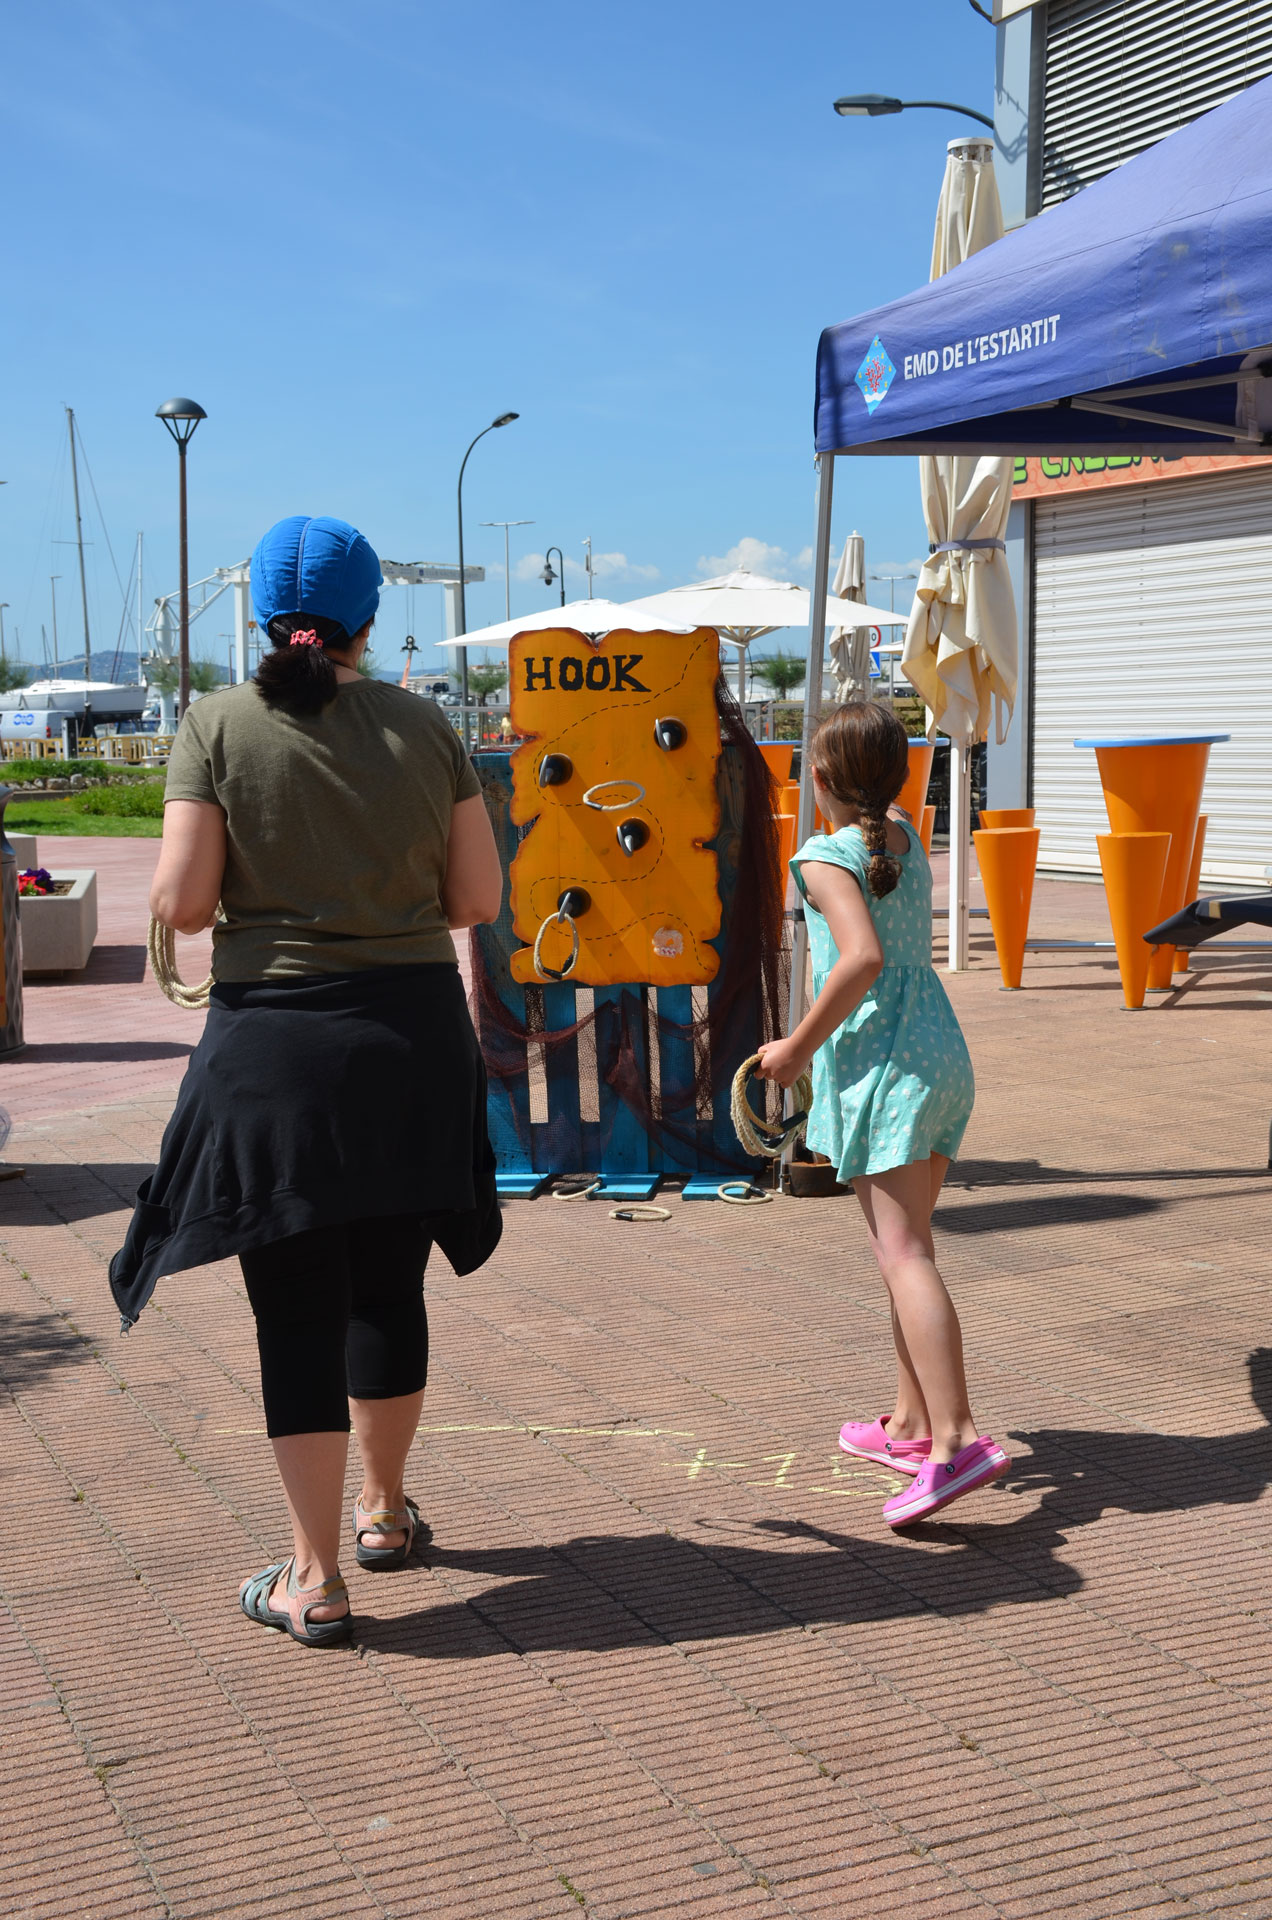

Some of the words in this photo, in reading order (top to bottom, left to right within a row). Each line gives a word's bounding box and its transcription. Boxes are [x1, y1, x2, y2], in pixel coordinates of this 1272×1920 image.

[904, 350, 939, 380] EMD
[942, 344, 964, 372] DE
[523, 654, 652, 692] HOOK
